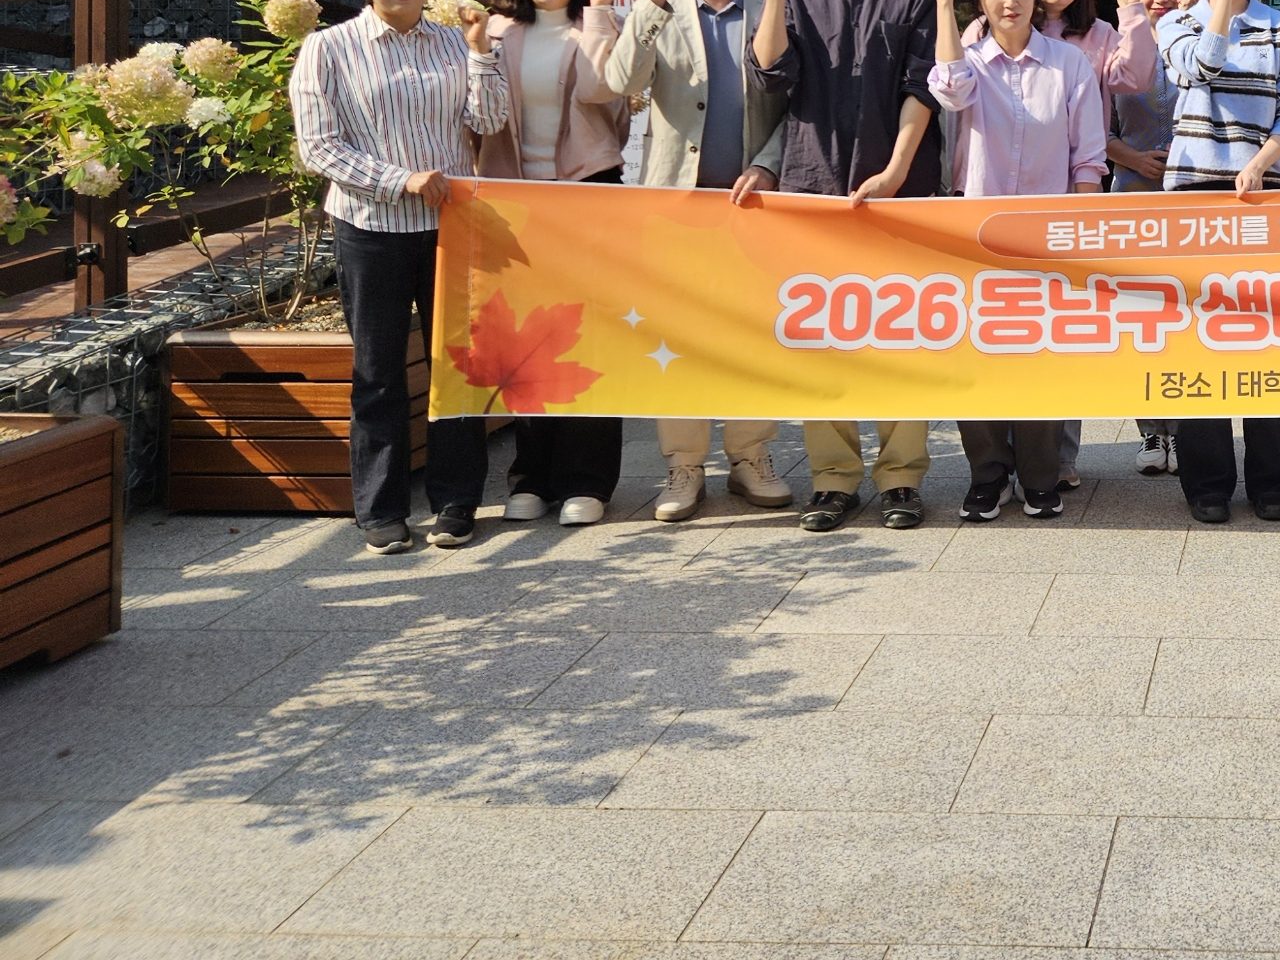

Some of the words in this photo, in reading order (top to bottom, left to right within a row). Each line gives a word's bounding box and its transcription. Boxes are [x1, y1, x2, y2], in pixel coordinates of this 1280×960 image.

[1046, 218, 1168, 251] 동남구의
[1178, 215, 1270, 247] 가치를
[783, 281, 959, 342] 2026
[977, 277, 1184, 345] 동남구
[1160, 371, 1212, 400] 장소
